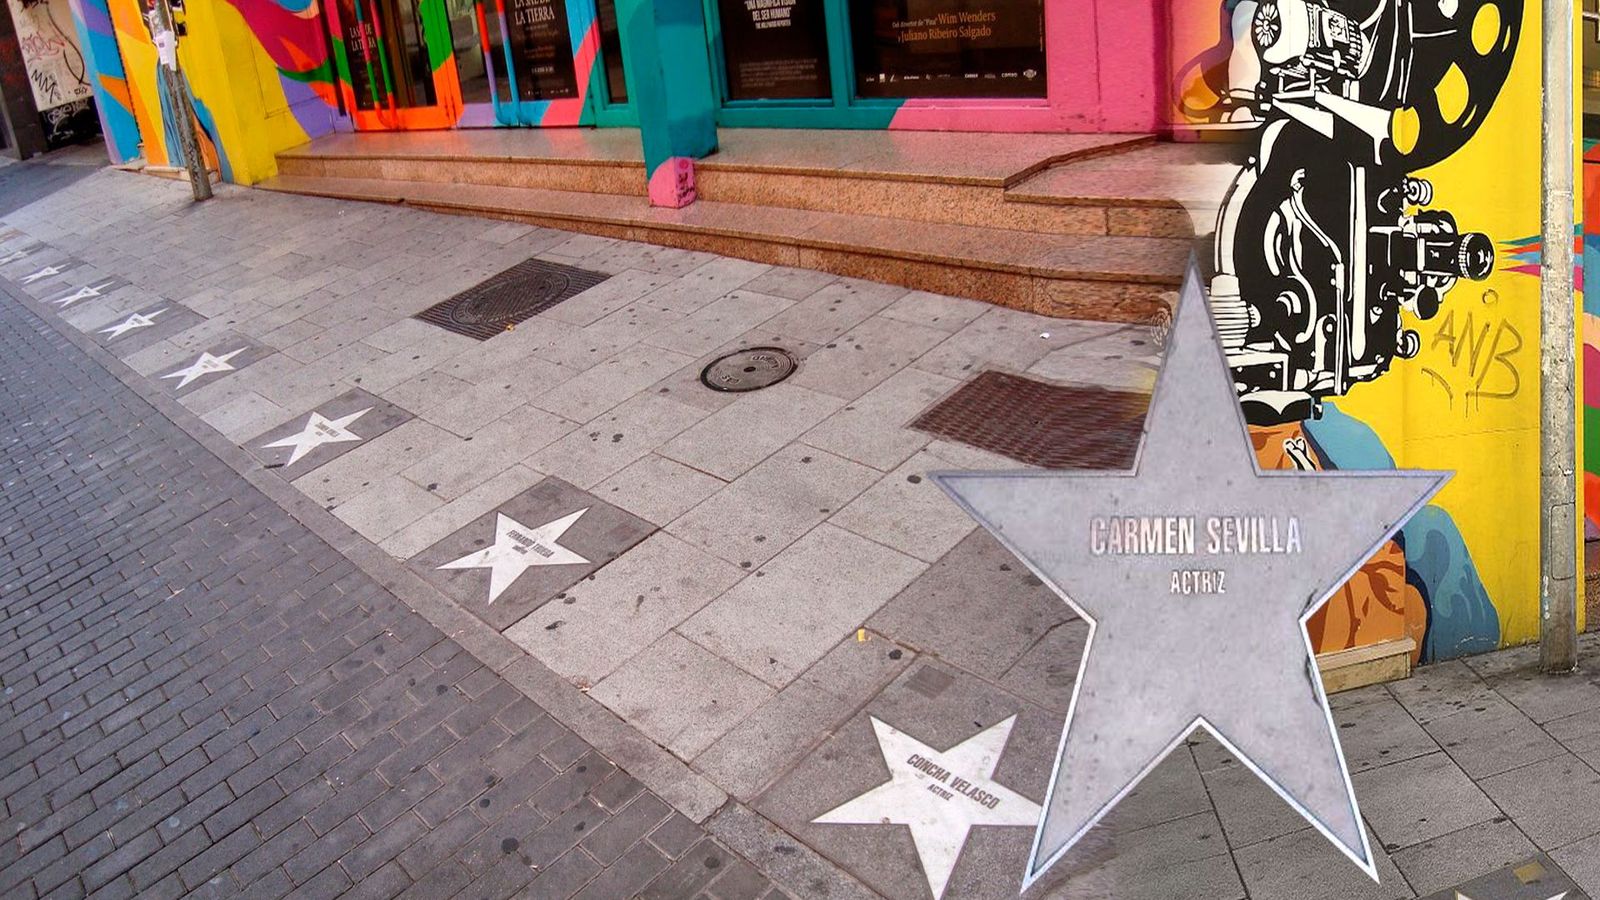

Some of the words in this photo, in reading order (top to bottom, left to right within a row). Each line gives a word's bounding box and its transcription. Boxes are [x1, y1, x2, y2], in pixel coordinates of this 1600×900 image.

[514, 11, 526, 25] LA
[525, 5, 555, 23] TIERRA
[938, 13, 958, 25] Wim
[959, 10, 996, 23] Wenders
[901, 29, 928, 43] Juliano
[929, 27, 958, 40] Ribeiro
[959, 24, 992, 40] Salgado
[1090, 515, 1195, 555] CARMEN
[1206, 515, 1302, 554] SEVILLA
[1170, 569, 1226, 595] ACTRIZ
[906, 753, 951, 783] CONCHA
[949, 776, 1001, 810] VELASCO
[927, 783, 954, 801] ACTRIZ
